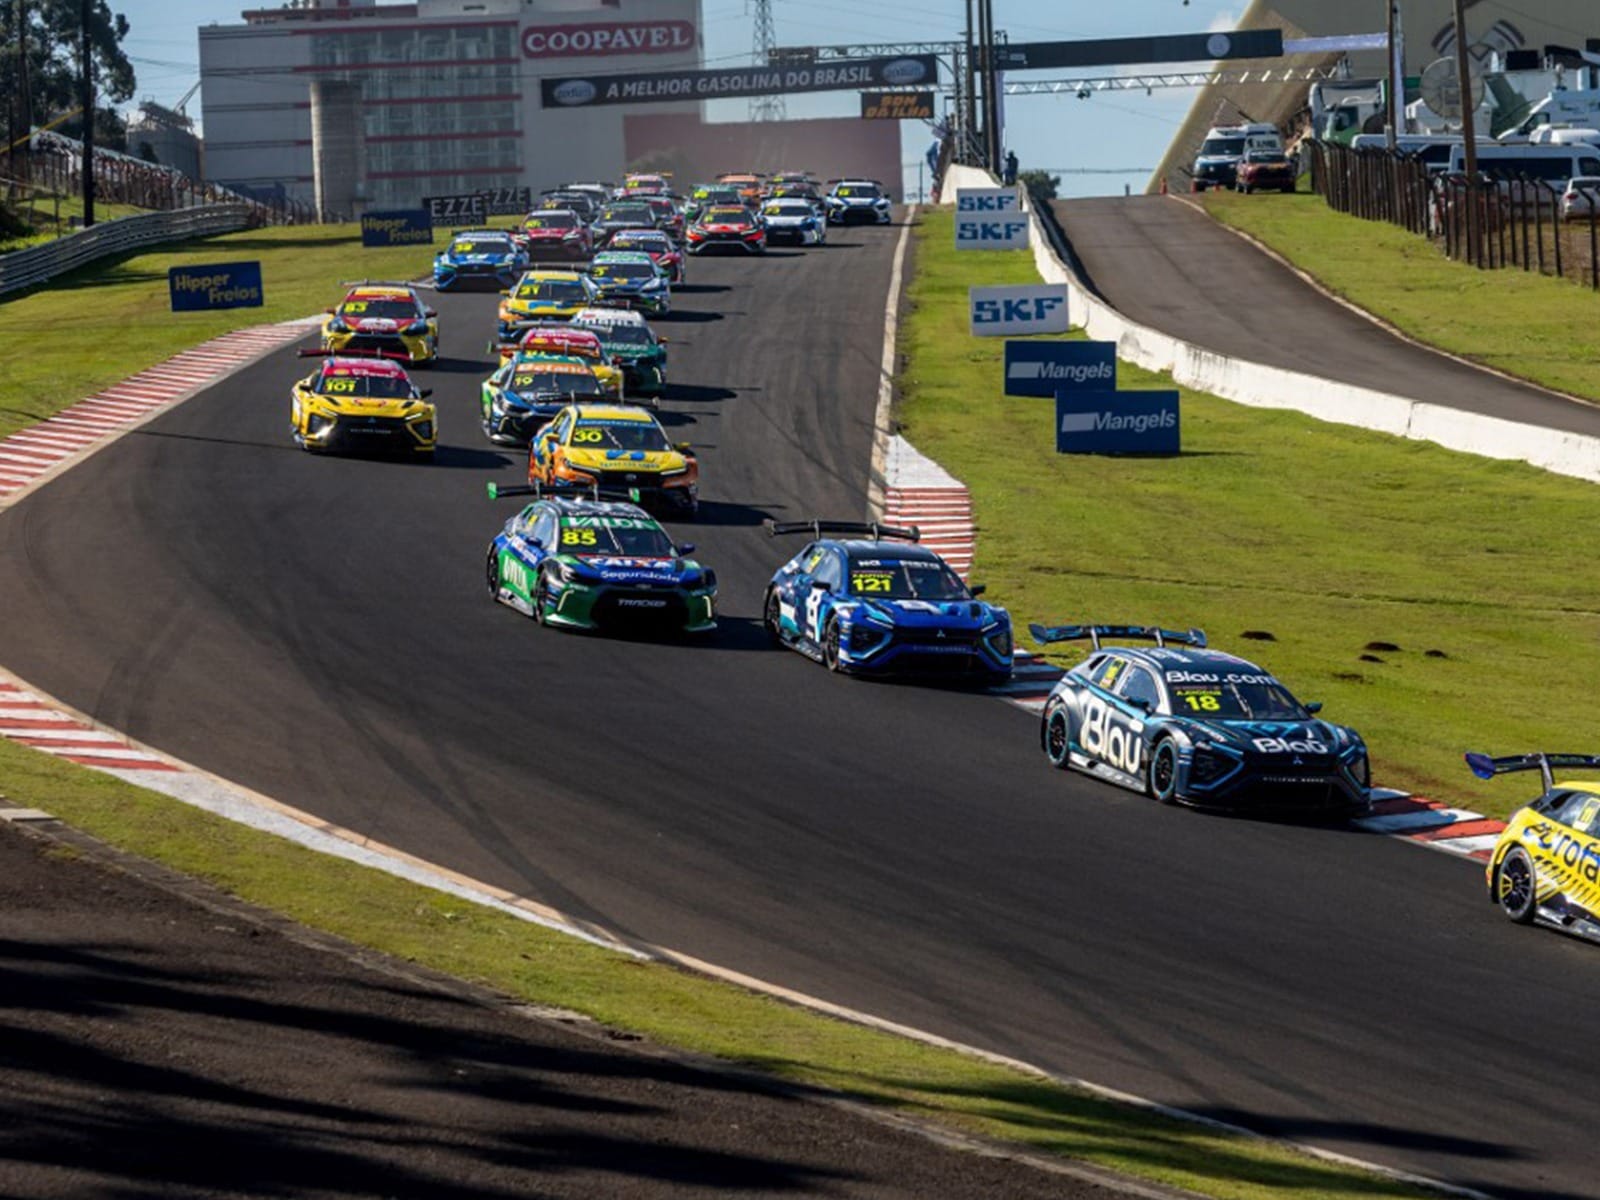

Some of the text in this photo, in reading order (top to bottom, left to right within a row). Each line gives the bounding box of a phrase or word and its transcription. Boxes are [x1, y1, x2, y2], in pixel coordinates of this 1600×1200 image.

[525, 26, 689, 52] COOPAVEL
[606, 66, 873, 98] A MELHOR GASOLINA DO BRASIL
[431, 197, 484, 217] EZZE
[958, 195, 1015, 212] SKF
[362, 217, 408, 231] Hipper
[958, 222, 1027, 240] SKF
[389, 229, 430, 243] Freios
[174, 273, 230, 292] Hipper
[208, 286, 259, 304] Freios
[972, 297, 1064, 323] SKF
[1037, 361, 1113, 382] Mangels
[325, 380, 357, 393] 101
[1092, 409, 1176, 432] Mangels
[574, 430, 603, 443] 30
[562, 531, 597, 545] 85
[852, 578, 891, 592] 121
[1185, 695, 1221, 712] 18
[1080, 696, 1144, 775] Blau
[1252, 728, 1328, 754] Blau
